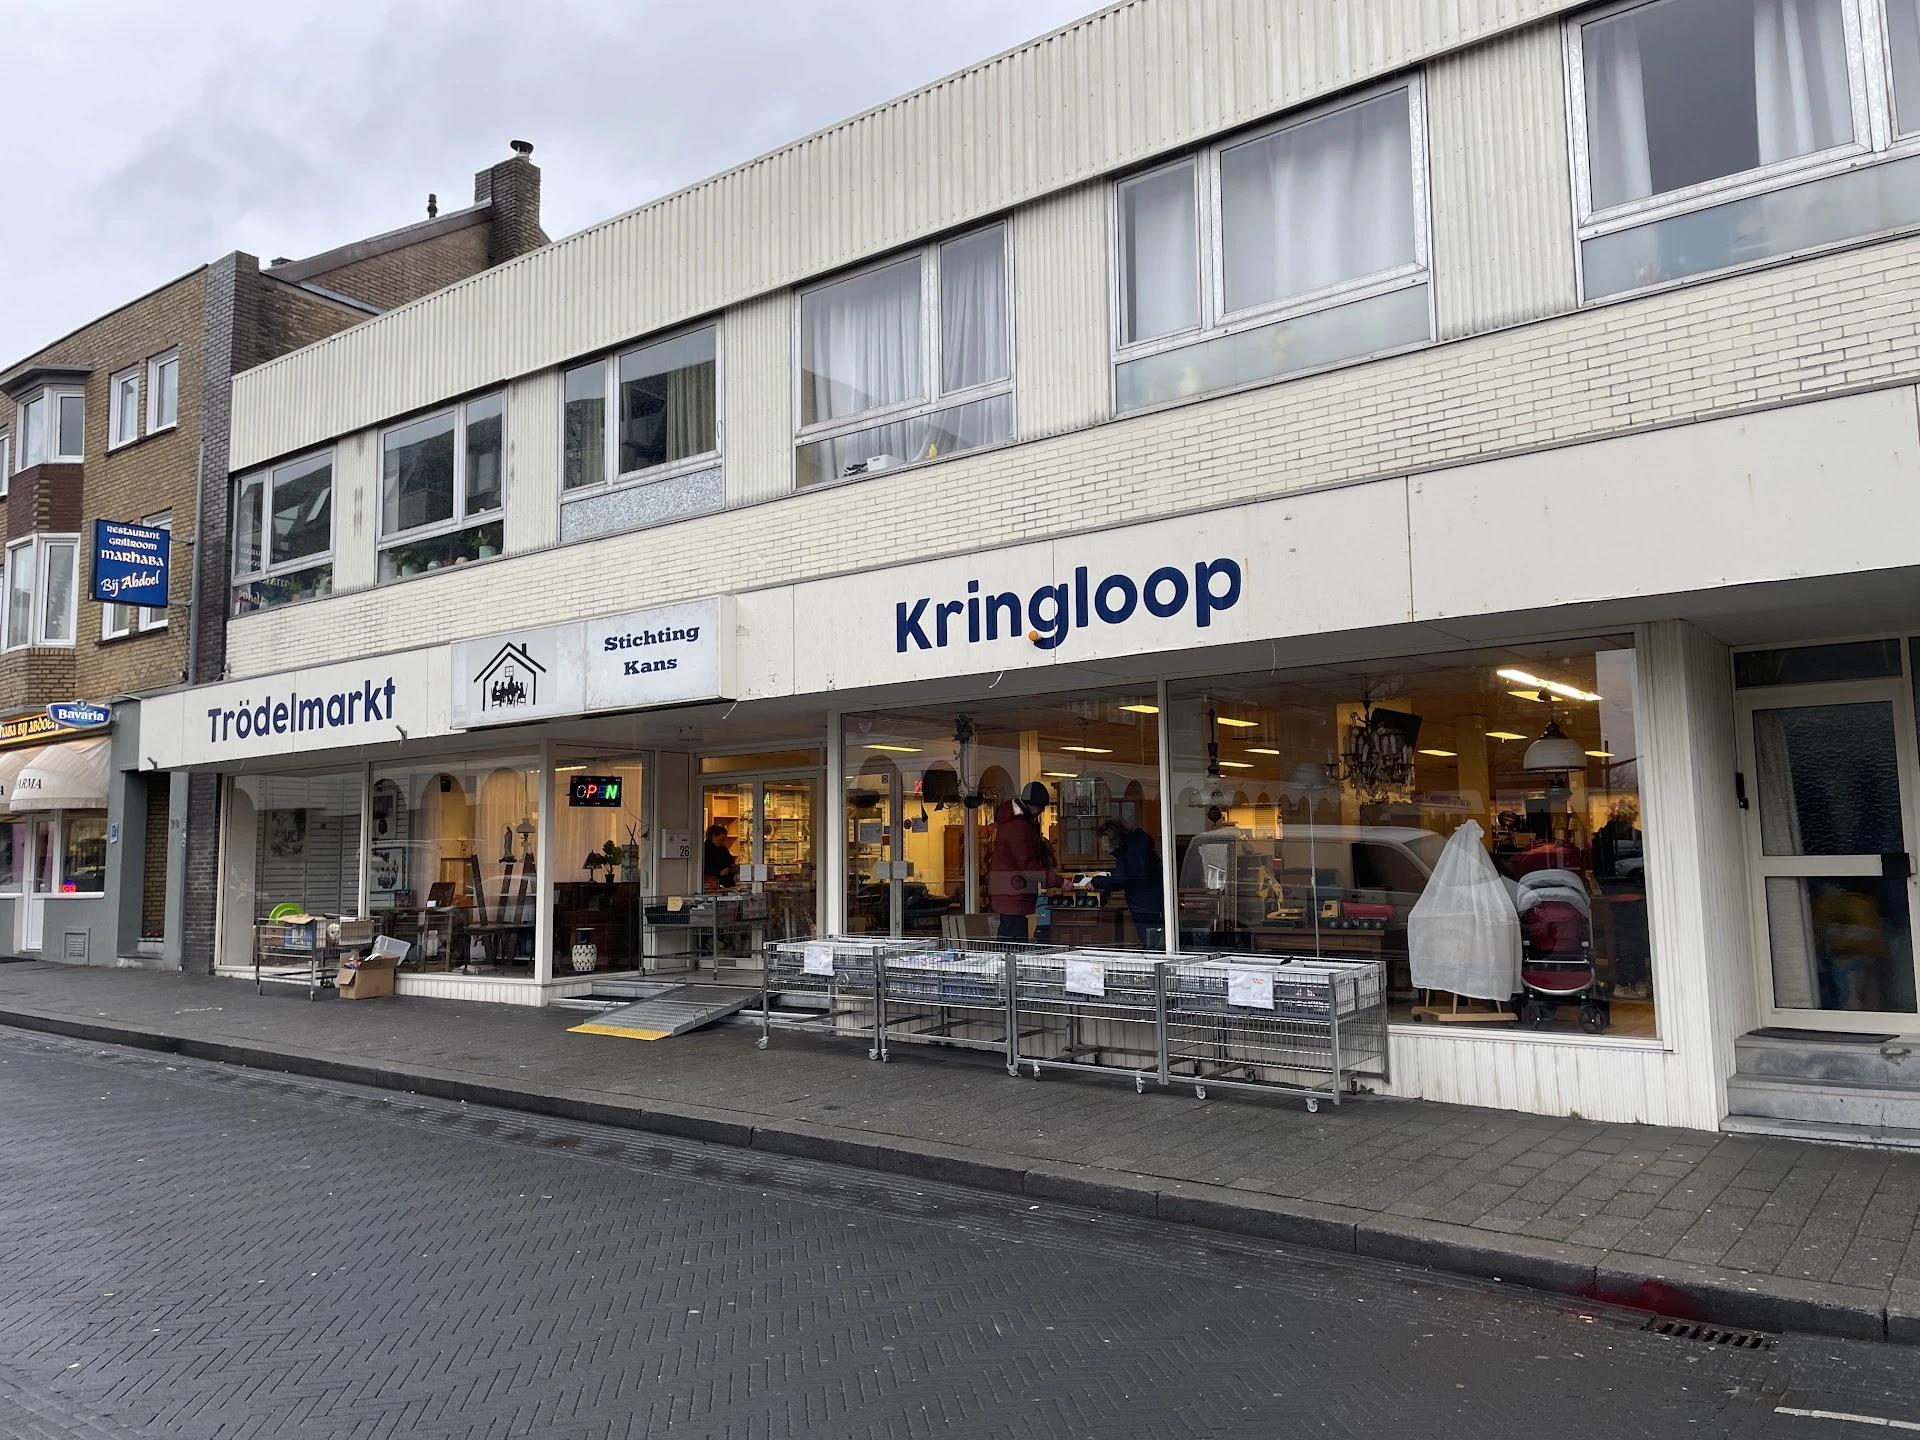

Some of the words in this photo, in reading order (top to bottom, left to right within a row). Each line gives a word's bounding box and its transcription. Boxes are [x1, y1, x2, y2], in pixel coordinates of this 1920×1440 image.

[101, 578, 119, 597] Bij
[121, 569, 161, 590] Abdoel
[896, 558, 1242, 653] Kringloop
[604, 626, 700, 651] Stichting
[623, 657, 678, 675] Kans
[58, 708, 105, 721] Bavaria
[208, 677, 396, 743] Trödelmarkt
[576, 784, 618, 800] OPEN
[680, 845, 690, 857] 26
